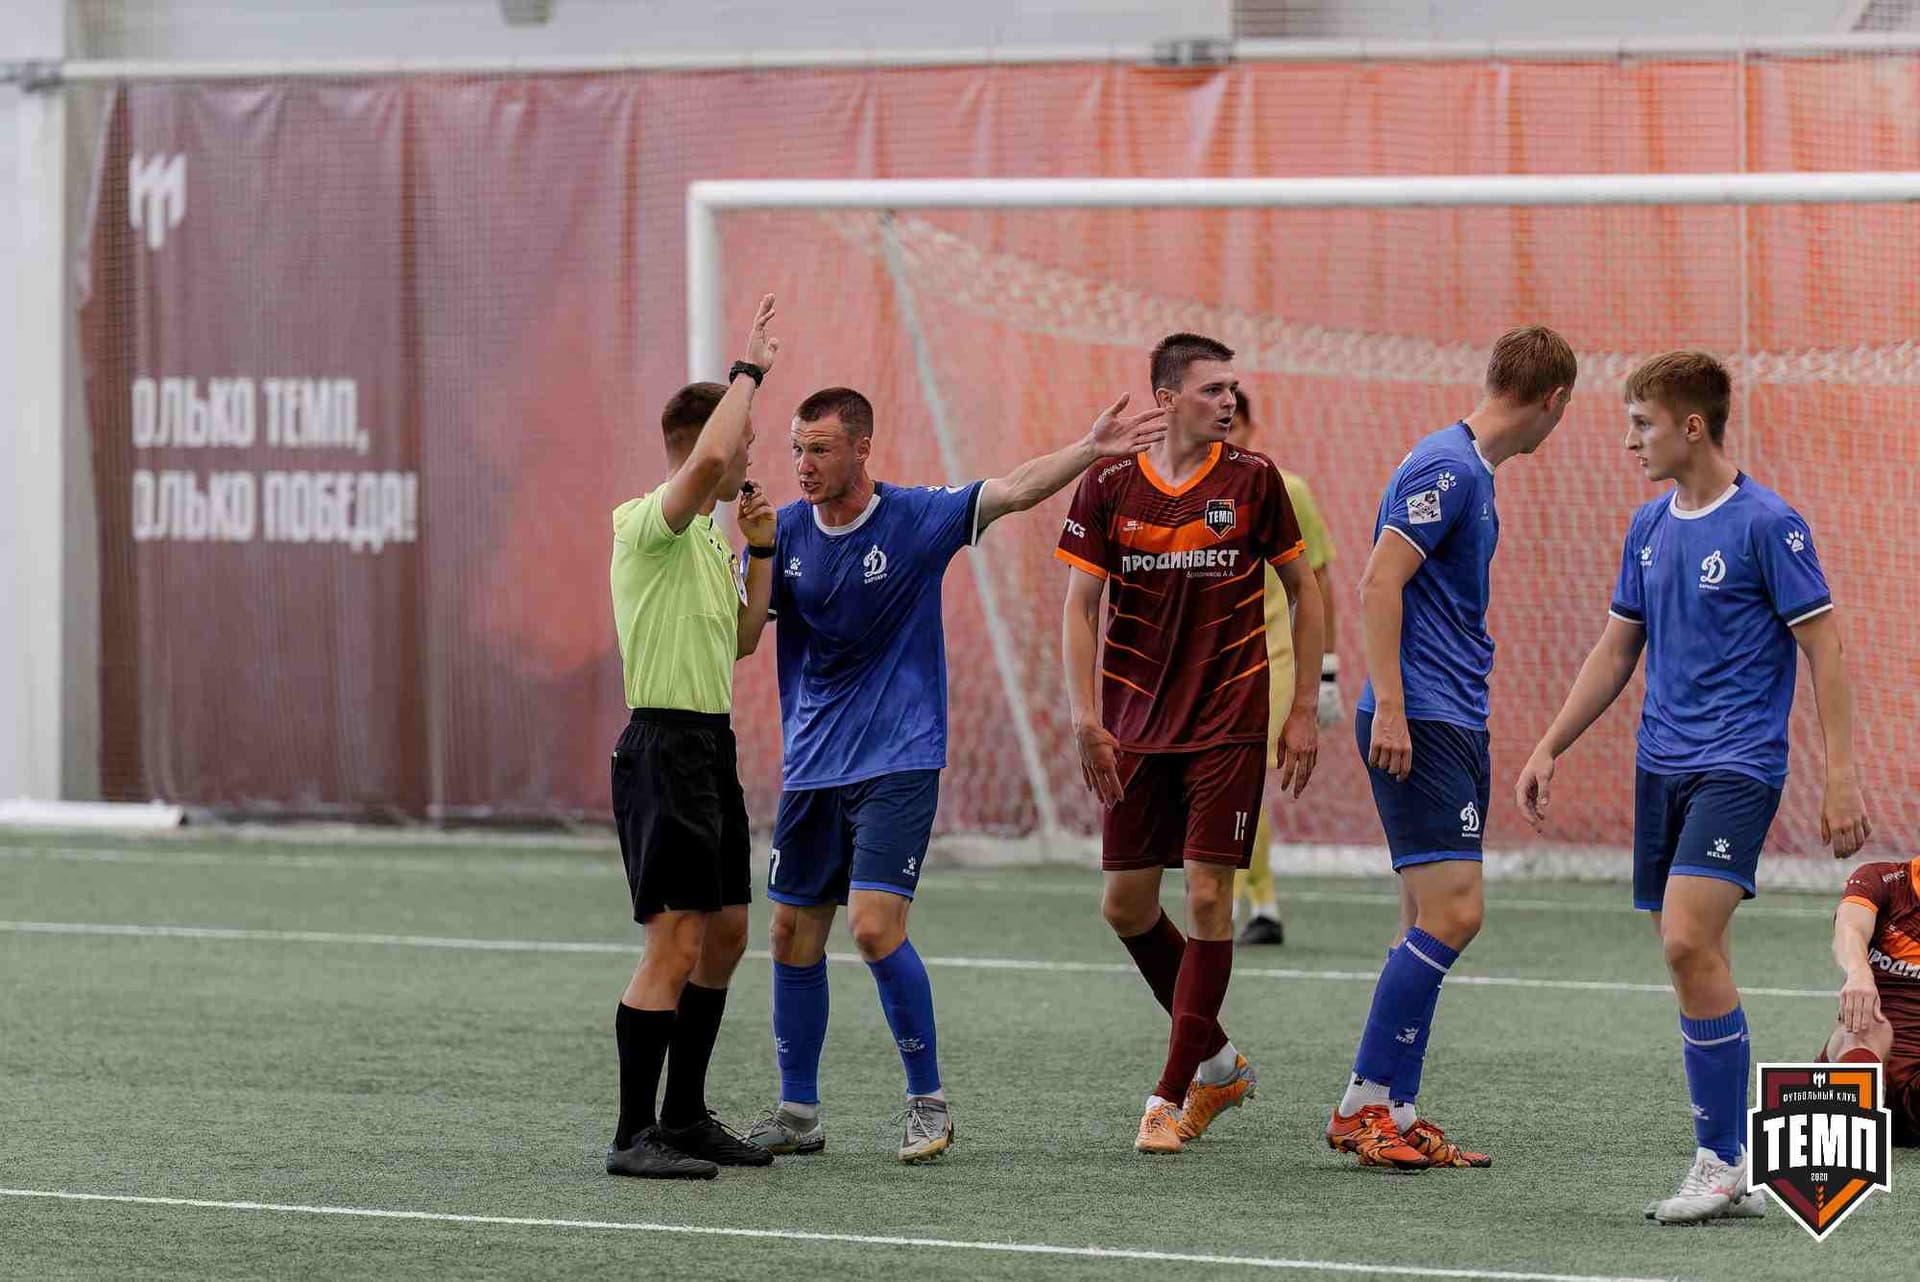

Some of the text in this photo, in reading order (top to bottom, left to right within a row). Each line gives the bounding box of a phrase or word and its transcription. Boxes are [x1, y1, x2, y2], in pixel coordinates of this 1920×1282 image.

[132, 376, 370, 456] ОЛЬКО ТЕМП,
[132, 470, 418, 553] ОЛЬКО ПОБЕДА!
[1208, 510, 1234, 525] ТЕМП
[1122, 549, 1240, 574] ПРОДИНВЕСТ
[1868, 947, 1920, 980] РОДИ
